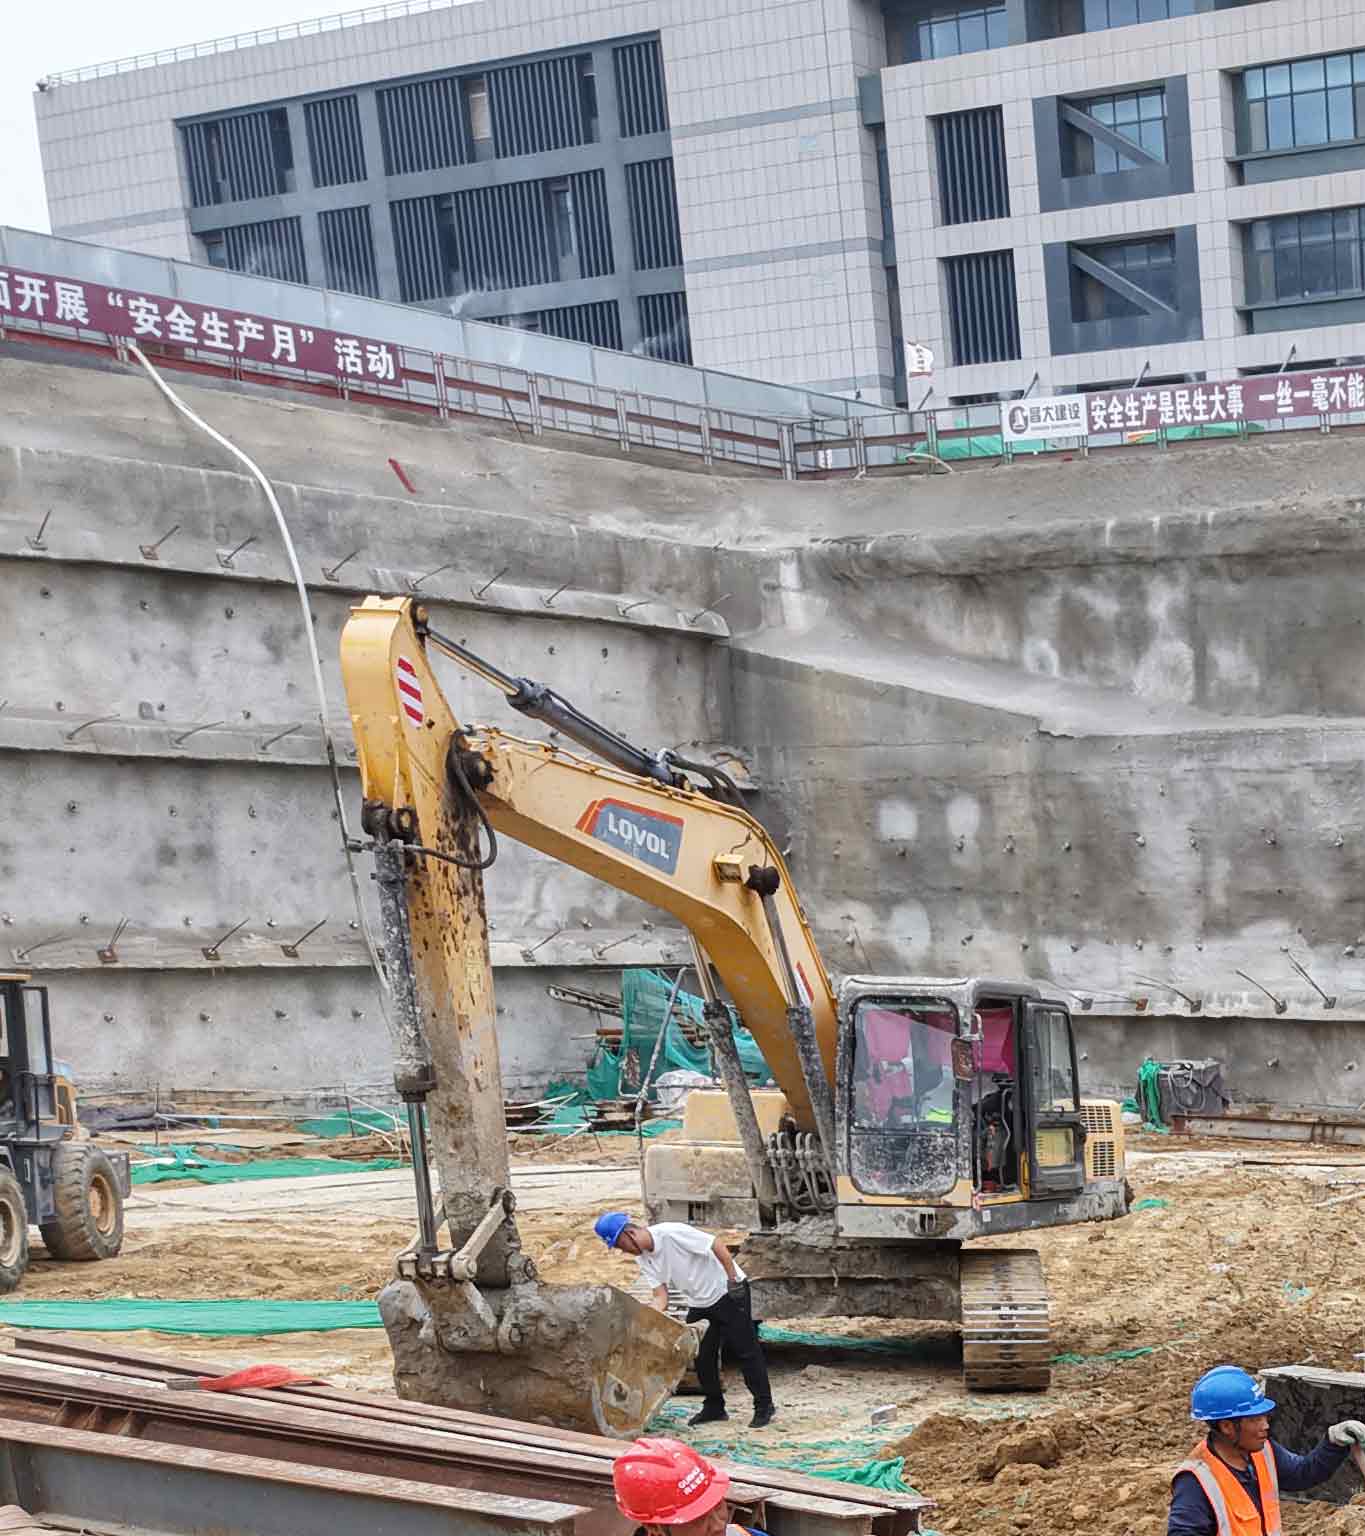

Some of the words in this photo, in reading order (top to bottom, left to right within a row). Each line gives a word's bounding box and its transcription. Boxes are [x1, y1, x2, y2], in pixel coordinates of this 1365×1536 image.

[1090, 384, 1245, 431] 安全生产是民生大事
[608, 811, 670, 860] LOVOL
